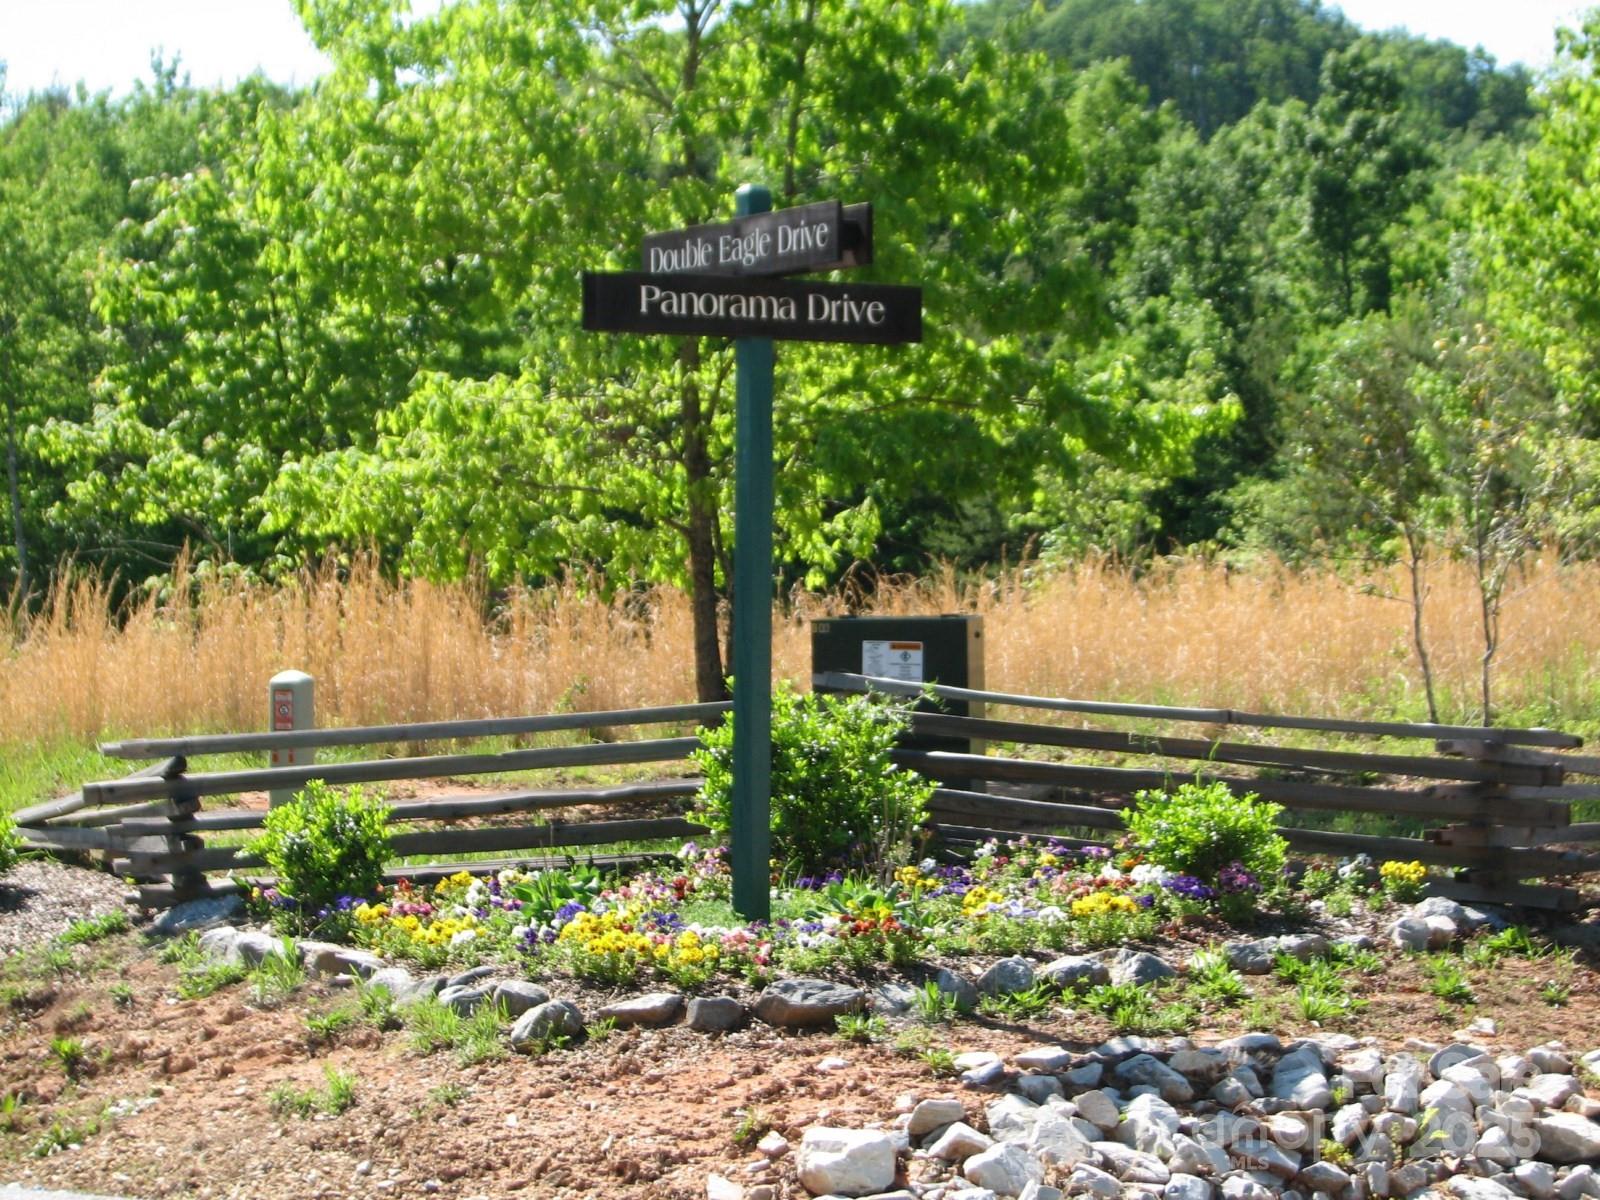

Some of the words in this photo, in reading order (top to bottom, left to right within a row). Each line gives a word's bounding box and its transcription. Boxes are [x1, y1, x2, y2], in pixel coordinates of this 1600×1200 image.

[650, 239, 713, 273] Double
[719, 228, 771, 266] Eagle
[778, 221, 829, 255] Drive
[640, 285, 797, 320] Panorama
[808, 293, 886, 324] Drive
